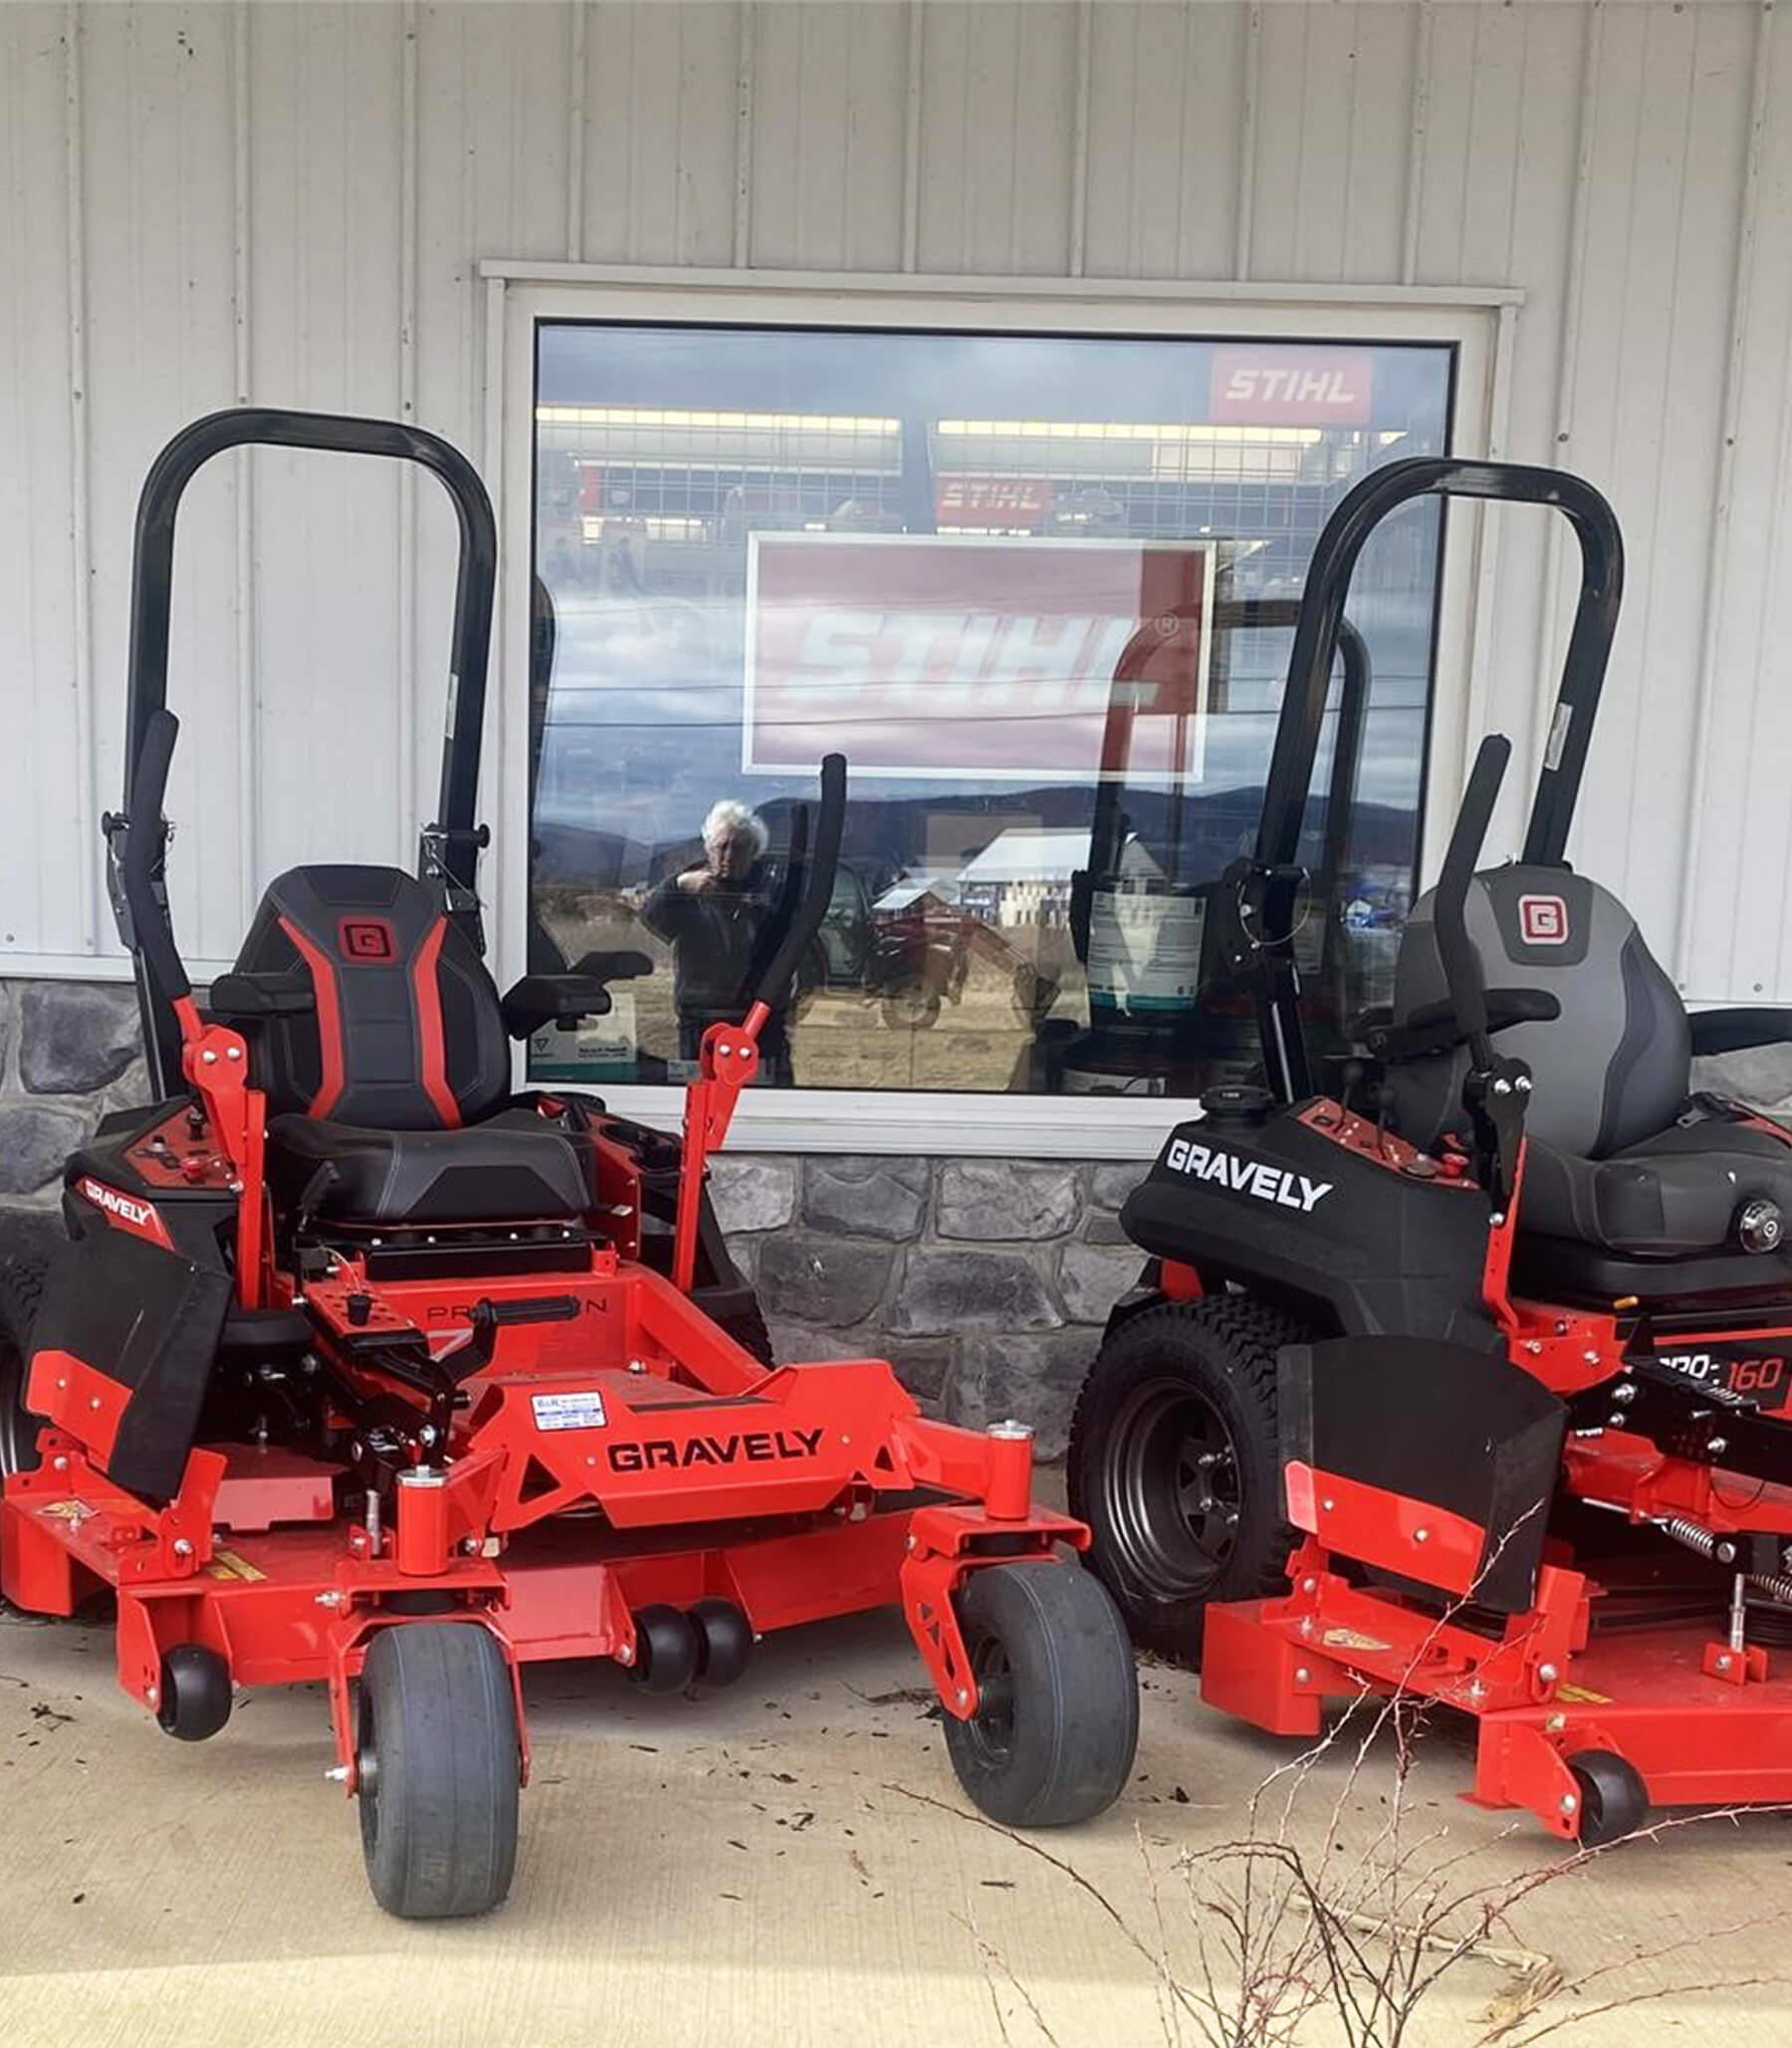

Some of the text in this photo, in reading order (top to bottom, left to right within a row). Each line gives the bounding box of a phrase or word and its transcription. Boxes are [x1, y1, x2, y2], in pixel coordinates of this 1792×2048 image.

[1226, 366, 1356, 403] STIHL
[941, 482, 1041, 510] STIHL
[784, 609, 1161, 709] STIHL
[1166, 1138, 1334, 1212] GRAVELY
[1727, 1357, 1784, 1391] 160
[607, 1428, 824, 1473] GRAVELY
